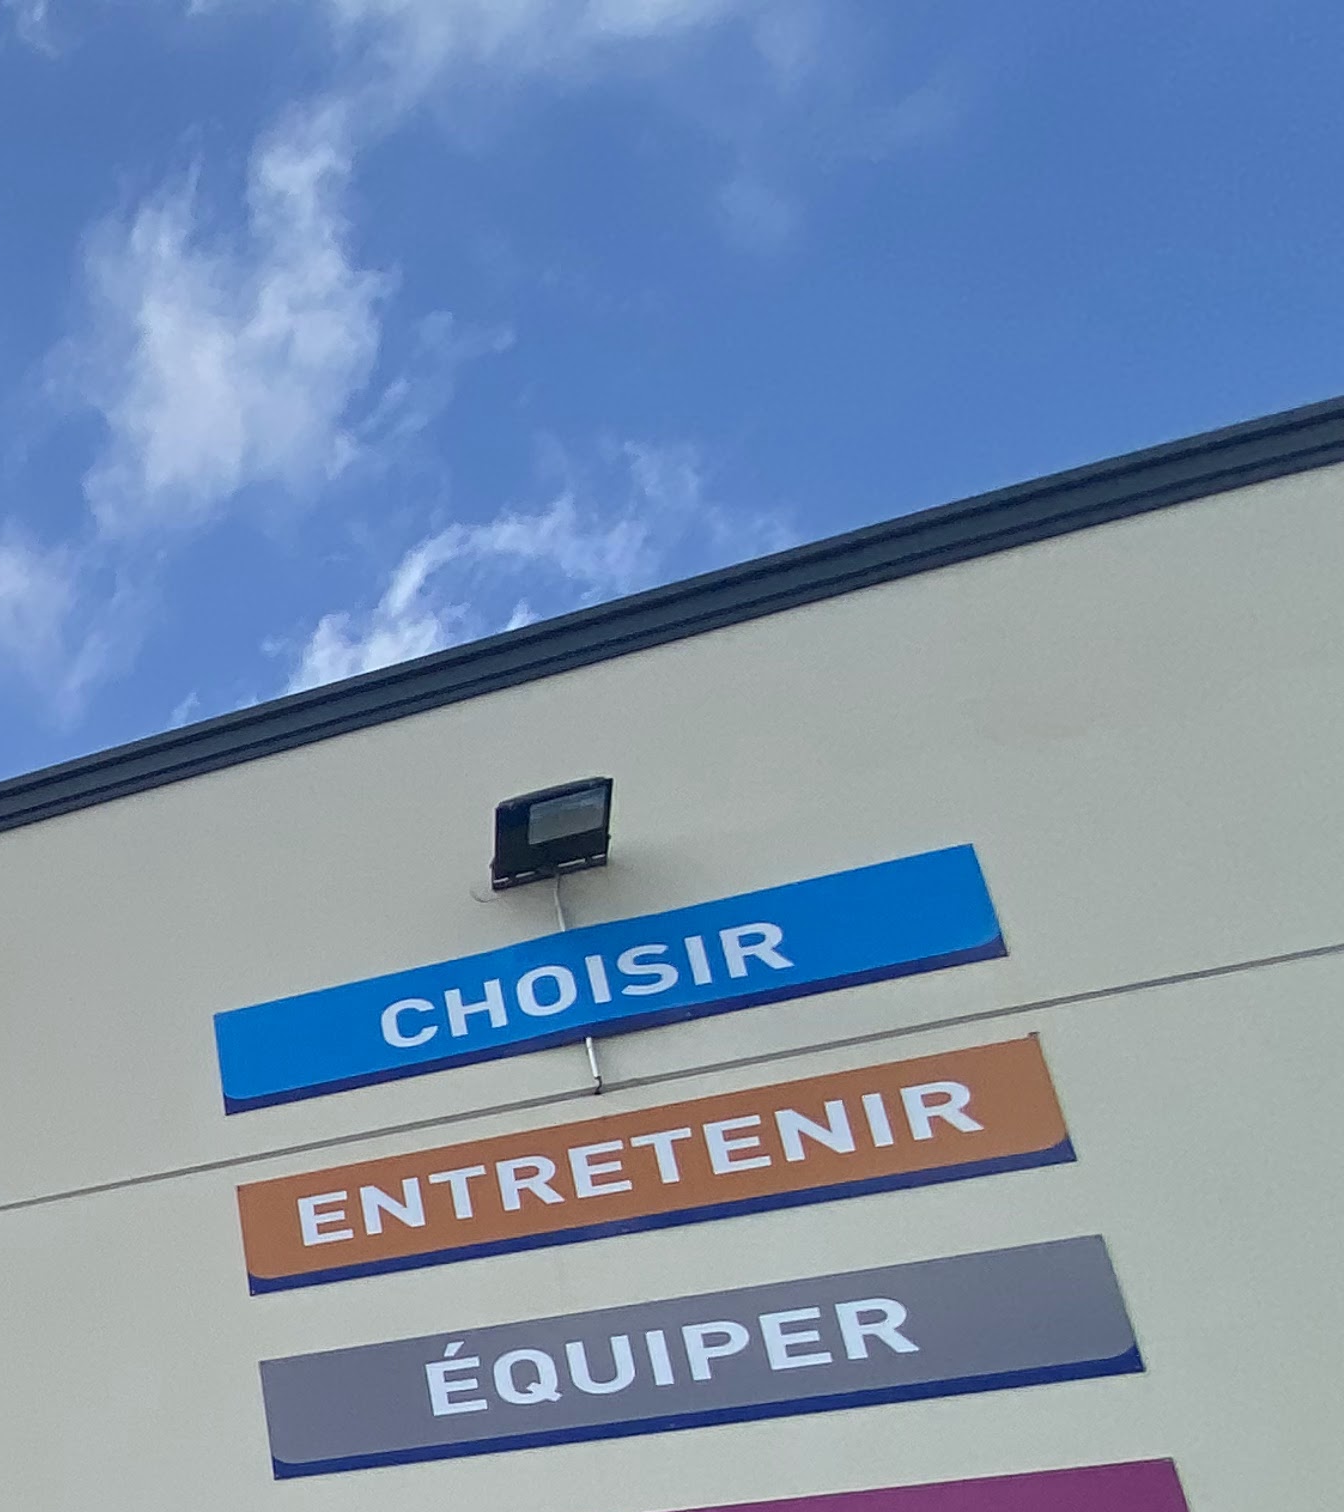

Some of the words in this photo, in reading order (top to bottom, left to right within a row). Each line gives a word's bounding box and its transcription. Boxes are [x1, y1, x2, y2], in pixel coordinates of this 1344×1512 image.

[378, 919, 796, 1049] CHOISIR
[296, 1080, 985, 1247] ENTRETENIR
[424, 1297, 921, 1417] ÉQUIPER
